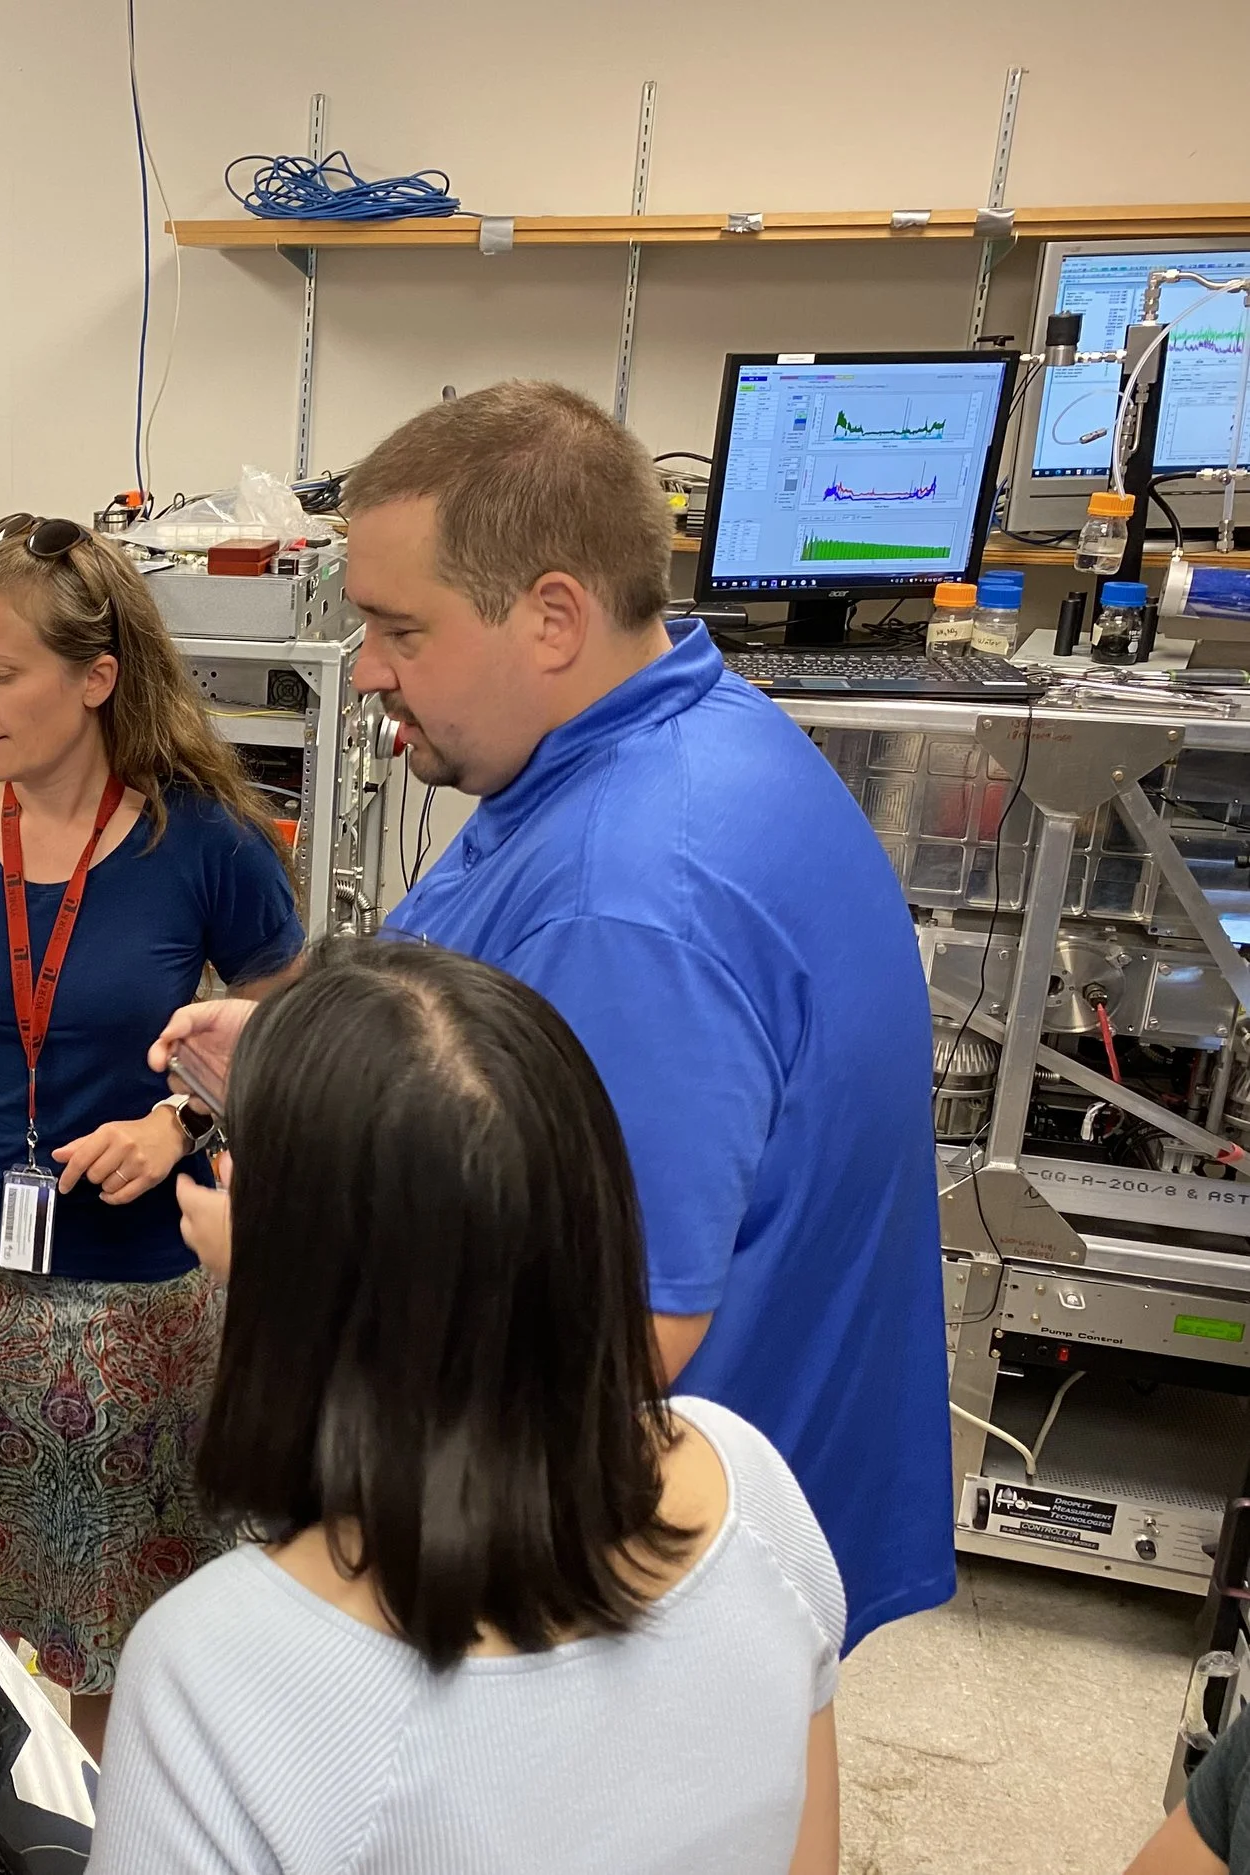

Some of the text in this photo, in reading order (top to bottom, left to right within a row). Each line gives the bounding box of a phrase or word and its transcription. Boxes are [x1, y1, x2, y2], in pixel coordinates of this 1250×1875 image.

[828, 590, 849, 598] acer
[34, 981, 49, 1010] YORK
[1187, 1188, 1198, 1200] &
[1040, 1326, 1123, 1345] Pump Control
[1053, 1497, 1092, 1510] DROPLET
[1050, 1511, 1112, 1529] TECHNOLOGIES
[1052, 1504, 1112, 1521] MEASUREMENT
[1021, 1522, 1080, 1539] CONTROLLER
